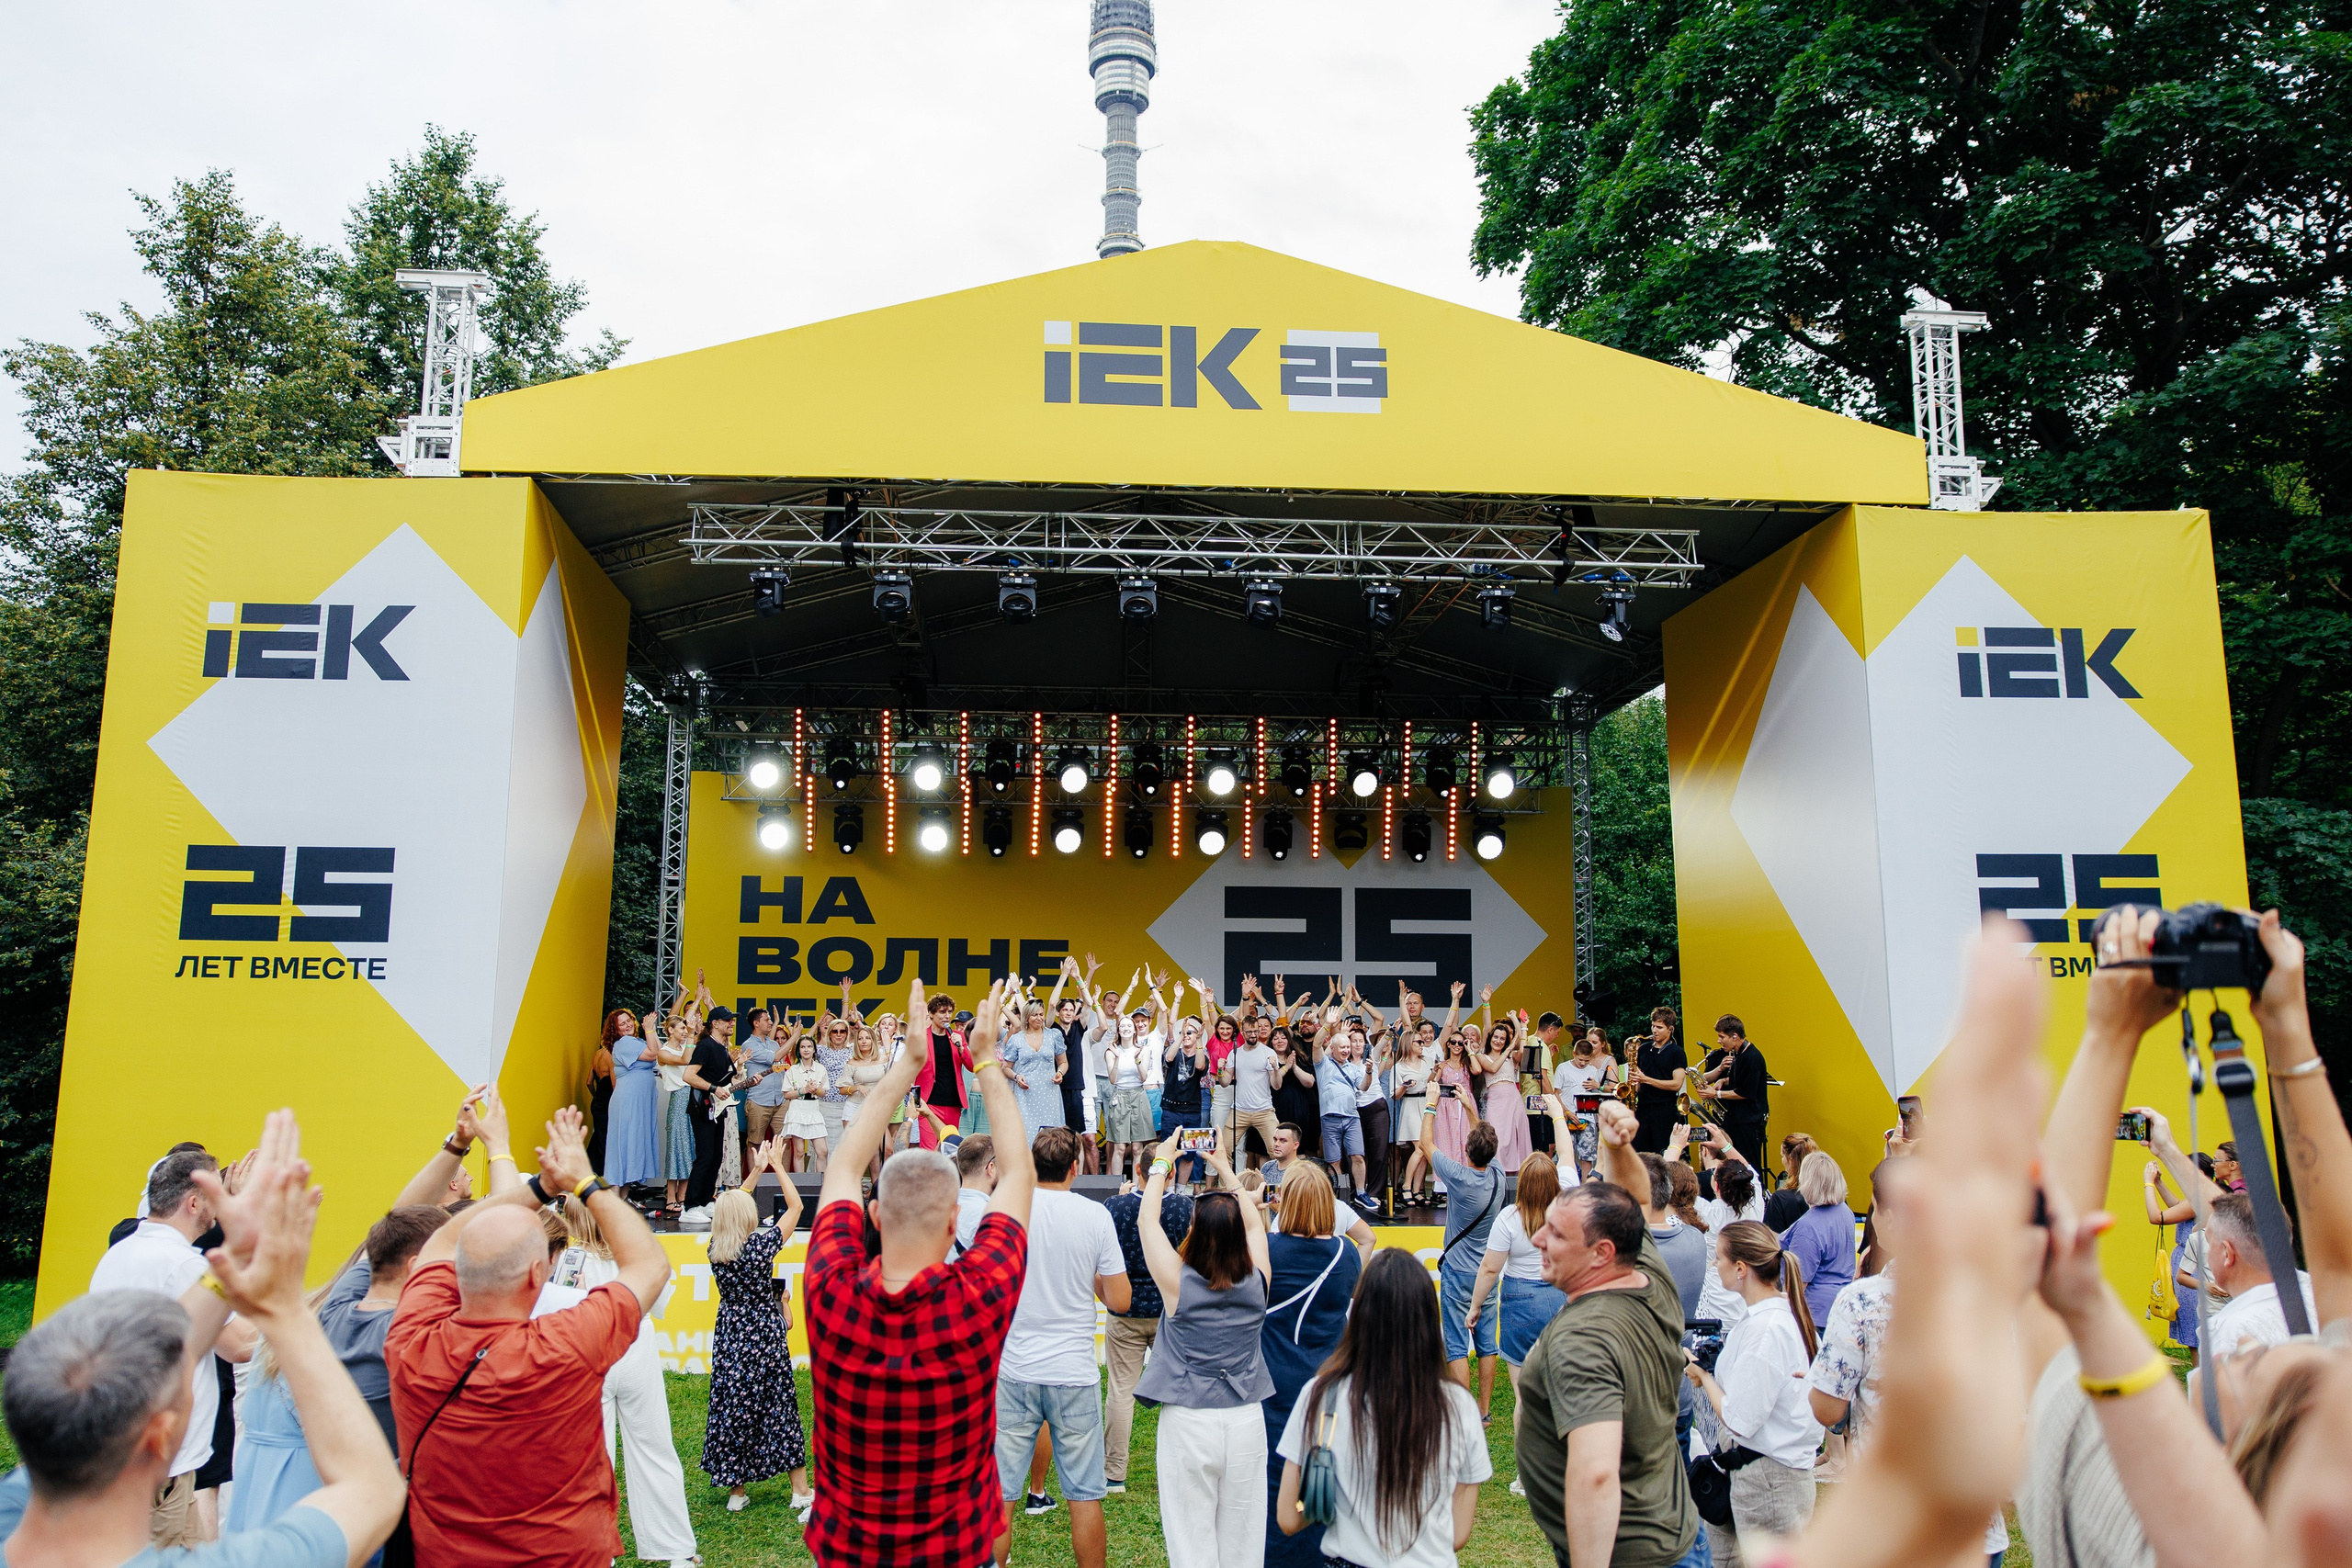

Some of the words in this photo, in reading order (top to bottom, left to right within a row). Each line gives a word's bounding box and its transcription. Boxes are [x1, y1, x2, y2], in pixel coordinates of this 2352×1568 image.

[1279, 344, 1388, 398] 25
[178, 844, 396, 942] 25
[739, 874, 876, 925] НА
[1975, 853, 2163, 943] 25
[175, 954, 243, 979] ЛЕТ
[249, 956, 388, 981] ВМЕСТЕ
[736, 935, 1069, 987] ВОЛНЕ
[1223, 886, 1474, 1009] 25
